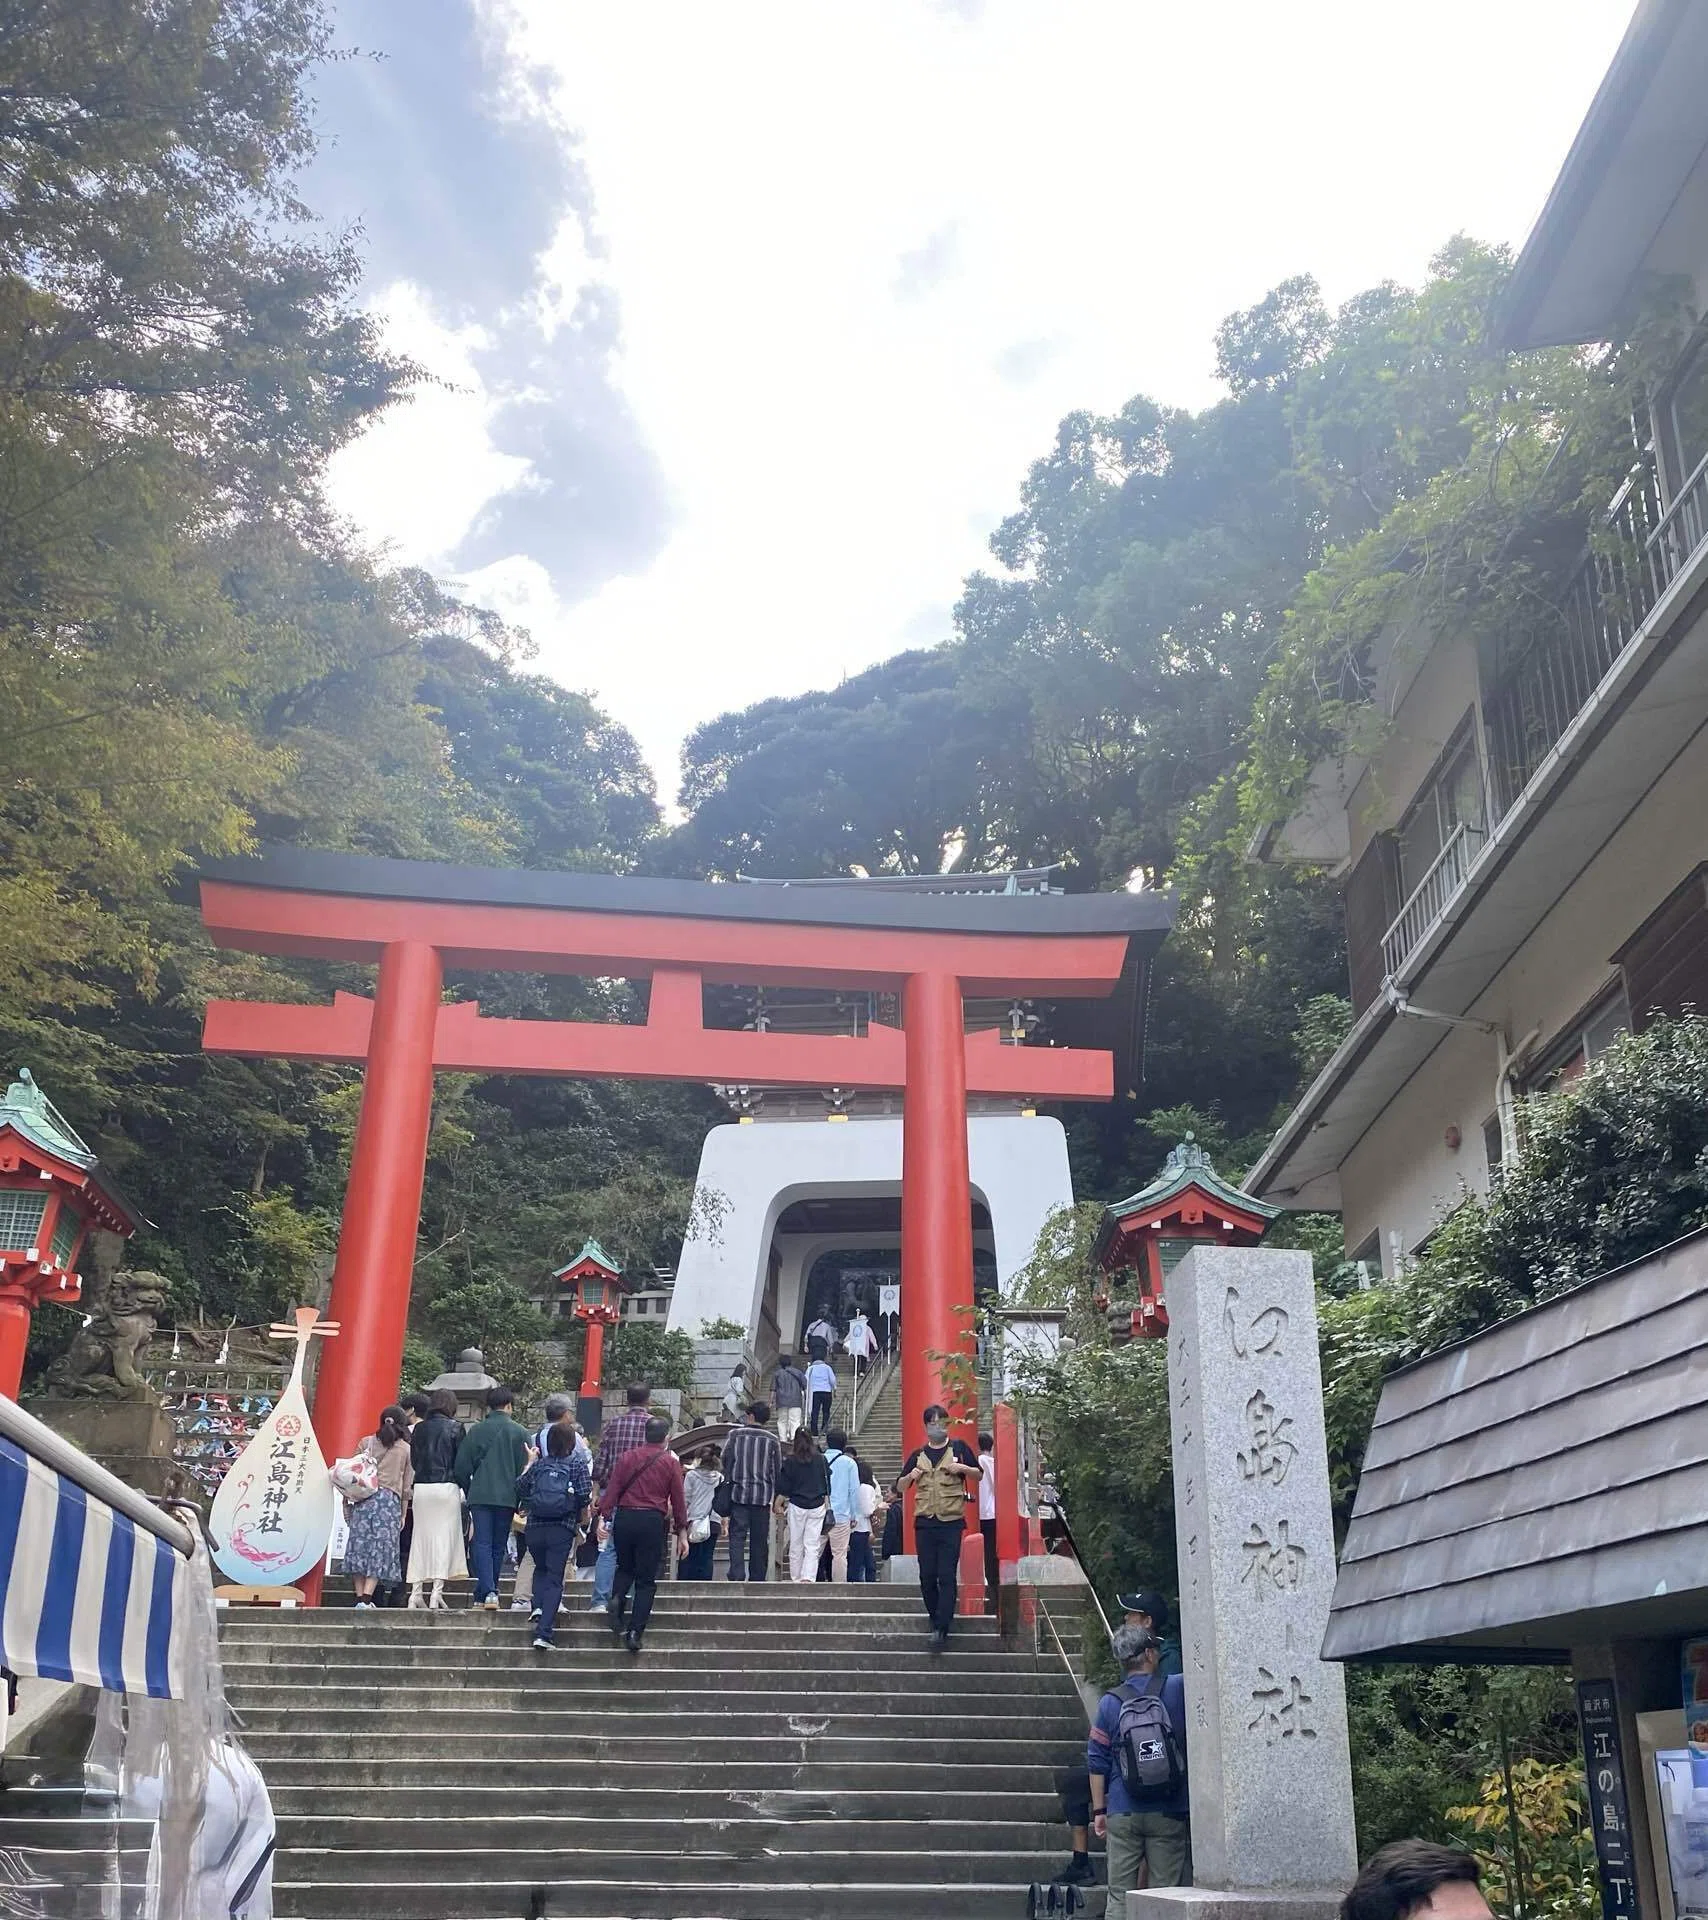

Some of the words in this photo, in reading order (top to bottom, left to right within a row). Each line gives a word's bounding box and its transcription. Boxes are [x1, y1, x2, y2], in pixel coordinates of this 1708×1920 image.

[256, 1436, 296, 1534] 江島神社
[1223, 1286, 1317, 1747] 江島神社
[1593, 1732, 1629, 1920] 江の島二丁
